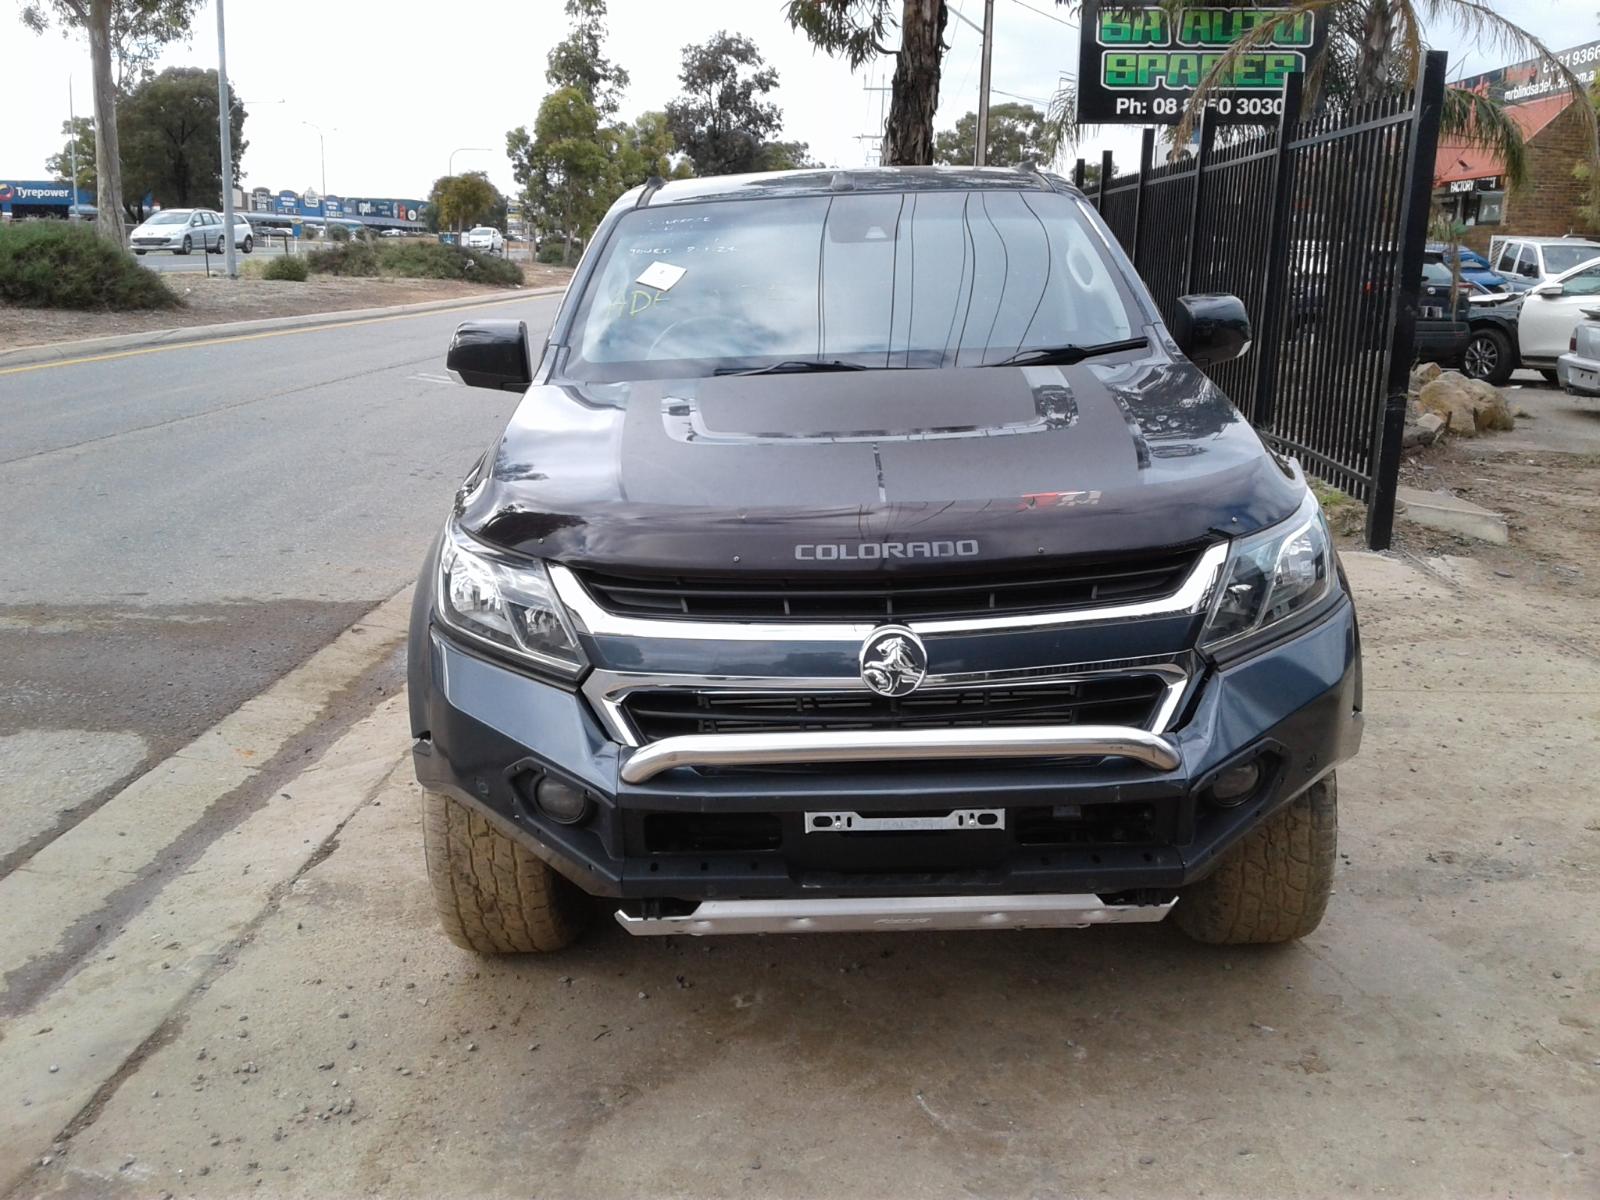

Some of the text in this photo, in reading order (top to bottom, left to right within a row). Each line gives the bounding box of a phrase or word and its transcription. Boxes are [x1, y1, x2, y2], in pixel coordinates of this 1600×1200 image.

[1101, 11, 1162, 42] SA
[1115, 97, 1147, 115] Ph:
[1152, 97, 1177, 115] 08
[1235, 97, 1284, 115] 3030
[15, 186, 69, 199] Tyrepower
[794, 539, 980, 561] COLORADO
